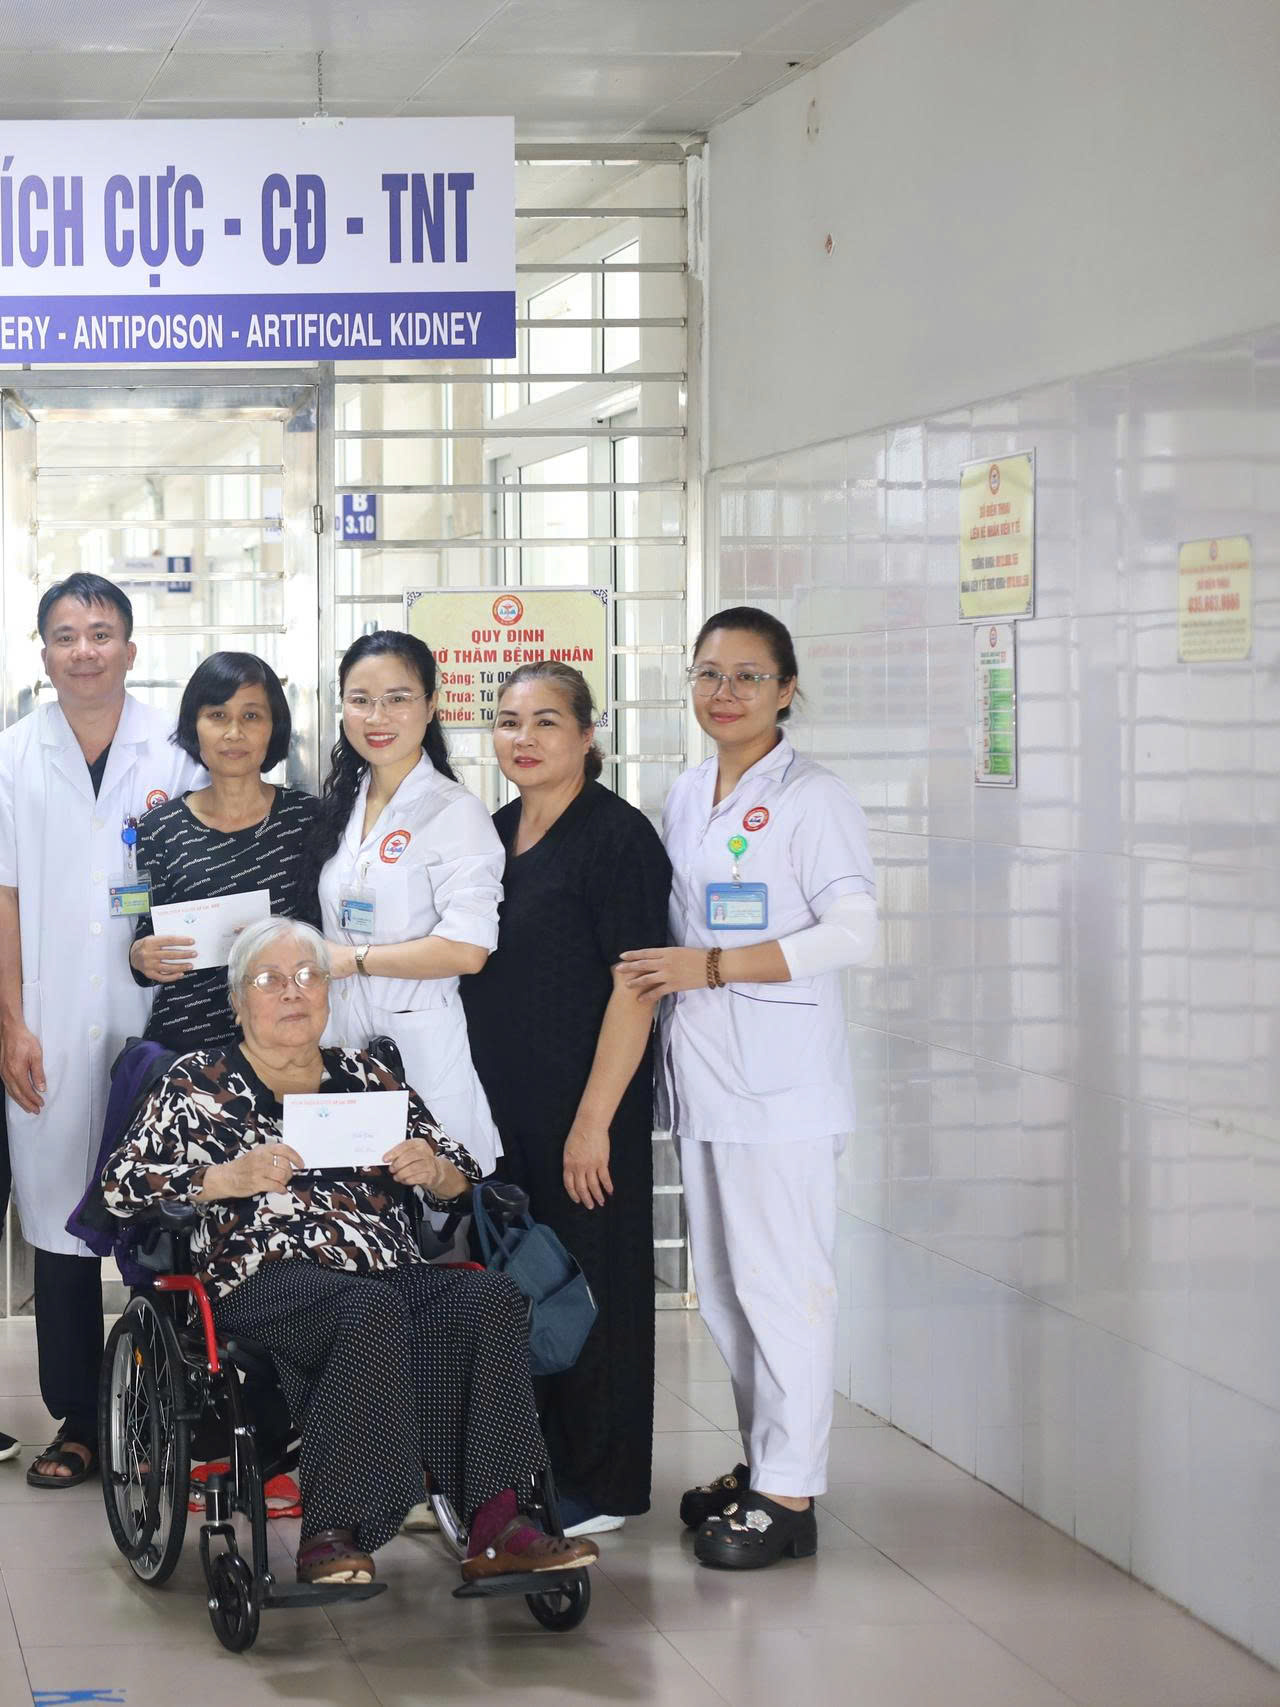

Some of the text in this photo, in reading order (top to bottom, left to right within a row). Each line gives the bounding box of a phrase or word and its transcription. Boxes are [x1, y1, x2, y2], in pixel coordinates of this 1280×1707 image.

[104, 165, 204, 288] CỰC
[224, 218, 241, 235] -
[261, 173, 326, 266] CĐ
[346, 217, 364, 234] -
[381, 172, 475, 263] TNT
[73, 314, 223, 349] ANTIPOISON
[247, 312, 382, 348] ARTIFICIAL
[390, 311, 482, 346] KIDNEY
[352, 494, 368, 512] B
[345, 515, 375, 534] 3.10
[472, 629, 545, 645] QUY ĐỊNH
[454, 648, 497, 663] THĂM
[503, 647, 545, 666] BỆNH
[550, 645, 593, 661] NHÂN
[441, 671, 475, 685] Sáng:
[480, 671, 493, 684] Từ
[445, 690, 493, 703] Trưa: Từ
[480, 708, 493, 721] Từ
